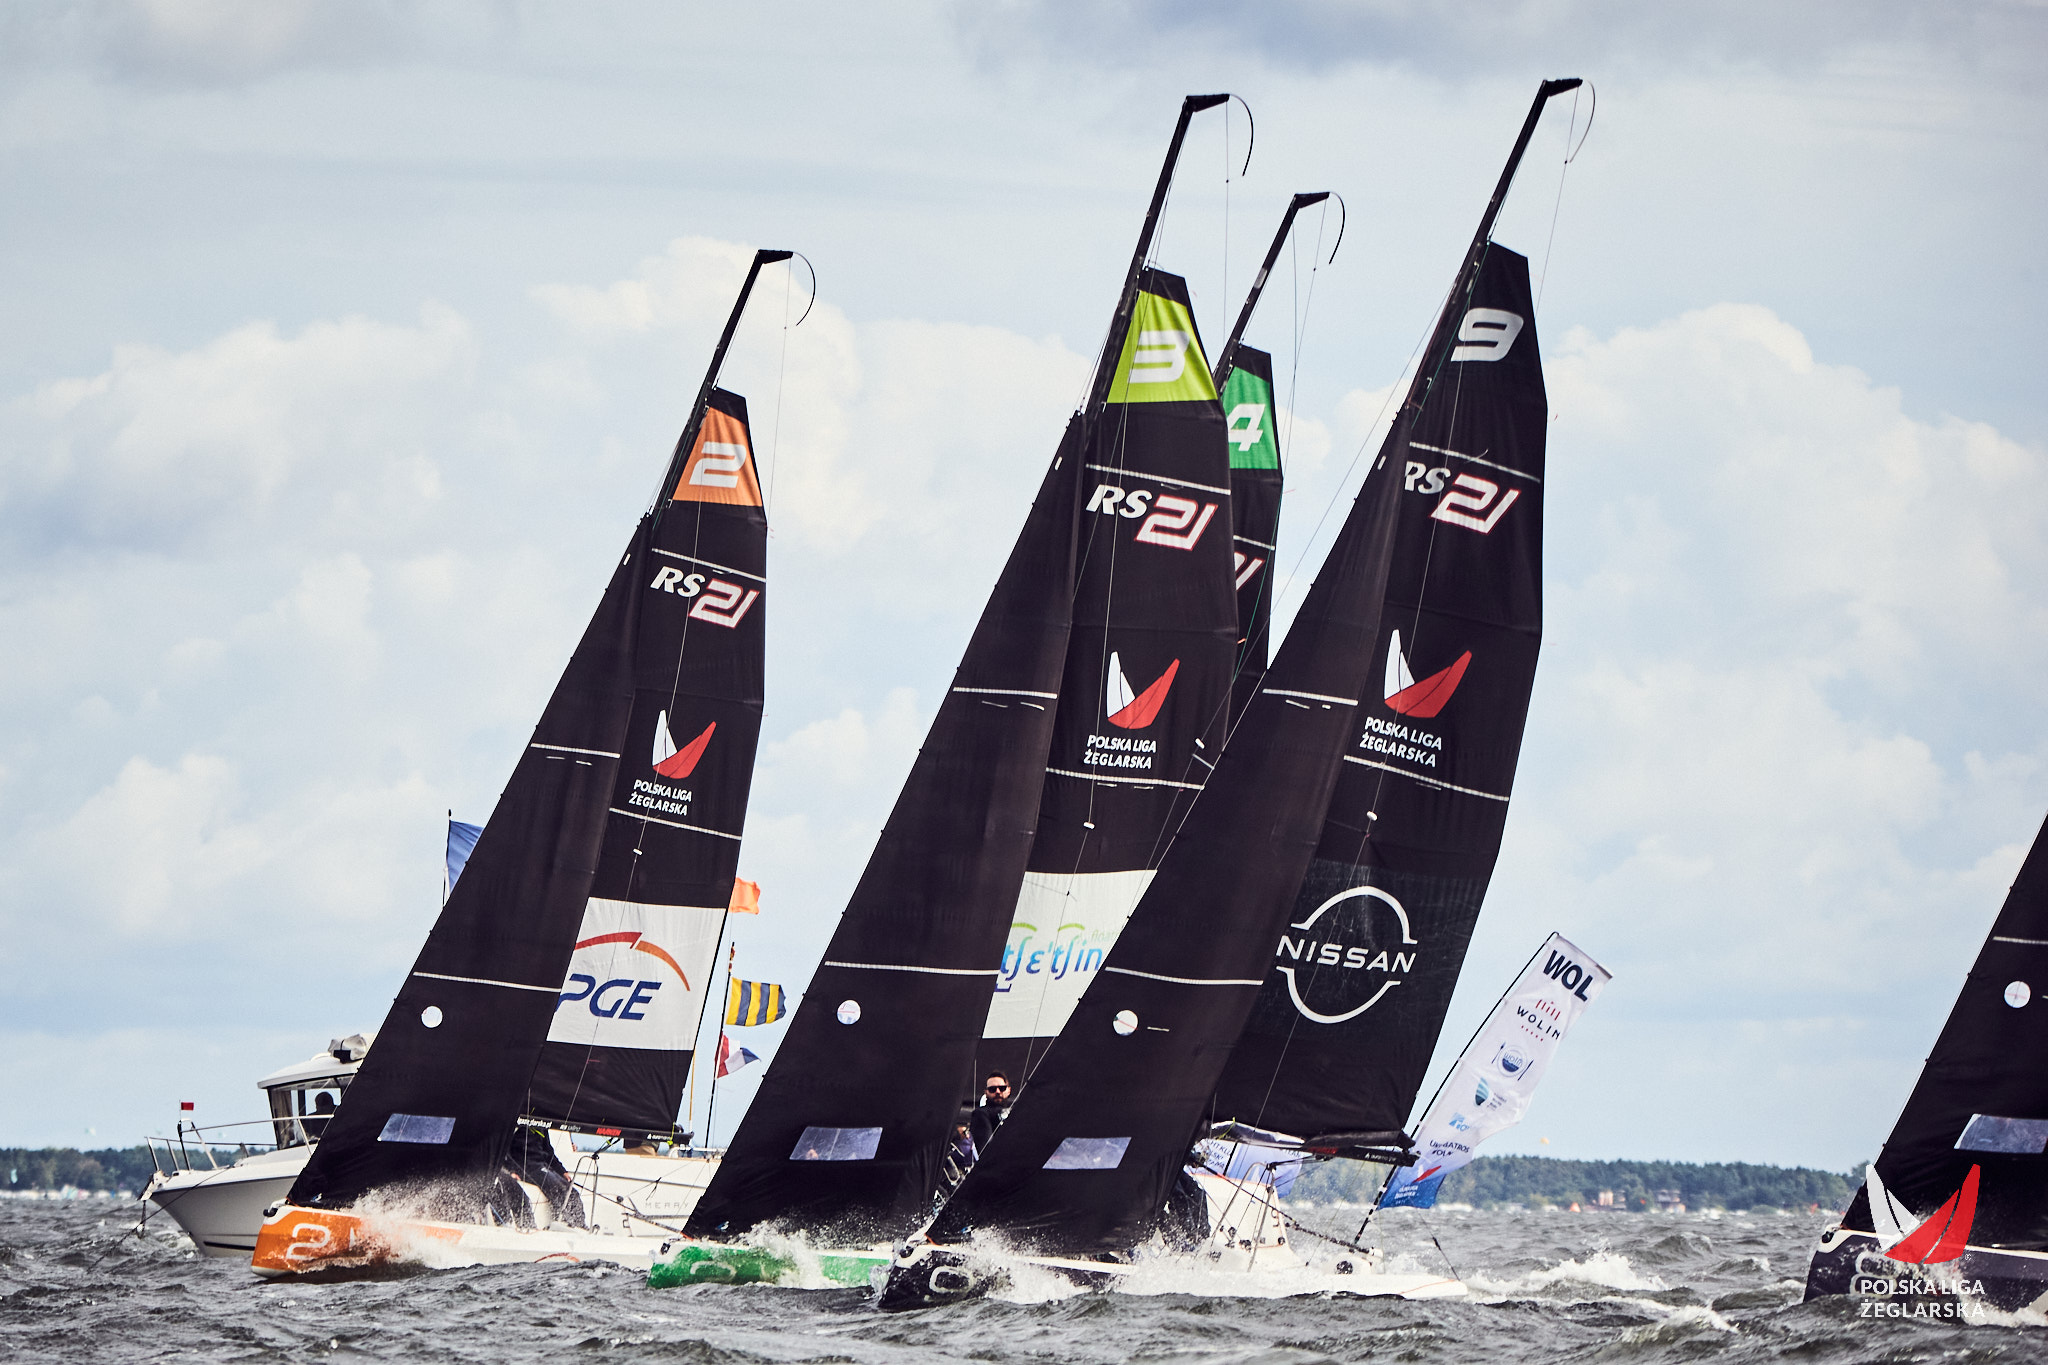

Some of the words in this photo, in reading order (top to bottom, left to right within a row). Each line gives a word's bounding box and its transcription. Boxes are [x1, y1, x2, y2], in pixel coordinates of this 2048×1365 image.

[1451, 307, 1525, 363] 9
[1128, 331, 1190, 384] 3
[1228, 404, 1265, 451] 4
[689, 441, 746, 488] 2
[1087, 734, 1133, 752] POLSKA
[1134, 739, 1157, 753] LIGA
[1360, 732, 1437, 767] ŻEGLARSKA
[1365, 716, 1409, 740] POLSKA
[1410, 727, 1442, 750] LIGA
[1083, 749, 1152, 769] ŻEGLARSKA
[628, 792, 688, 816] ŻEGLARSKA
[633, 779, 672, 797] POLSKA
[673, 788, 692, 802] LIGA
[1276, 935, 1416, 973] NISSAN
[1543, 949, 1594, 1002] WOL
[554, 973, 662, 1020] PGE
[1516, 1005, 1560, 1040] WOLIN
